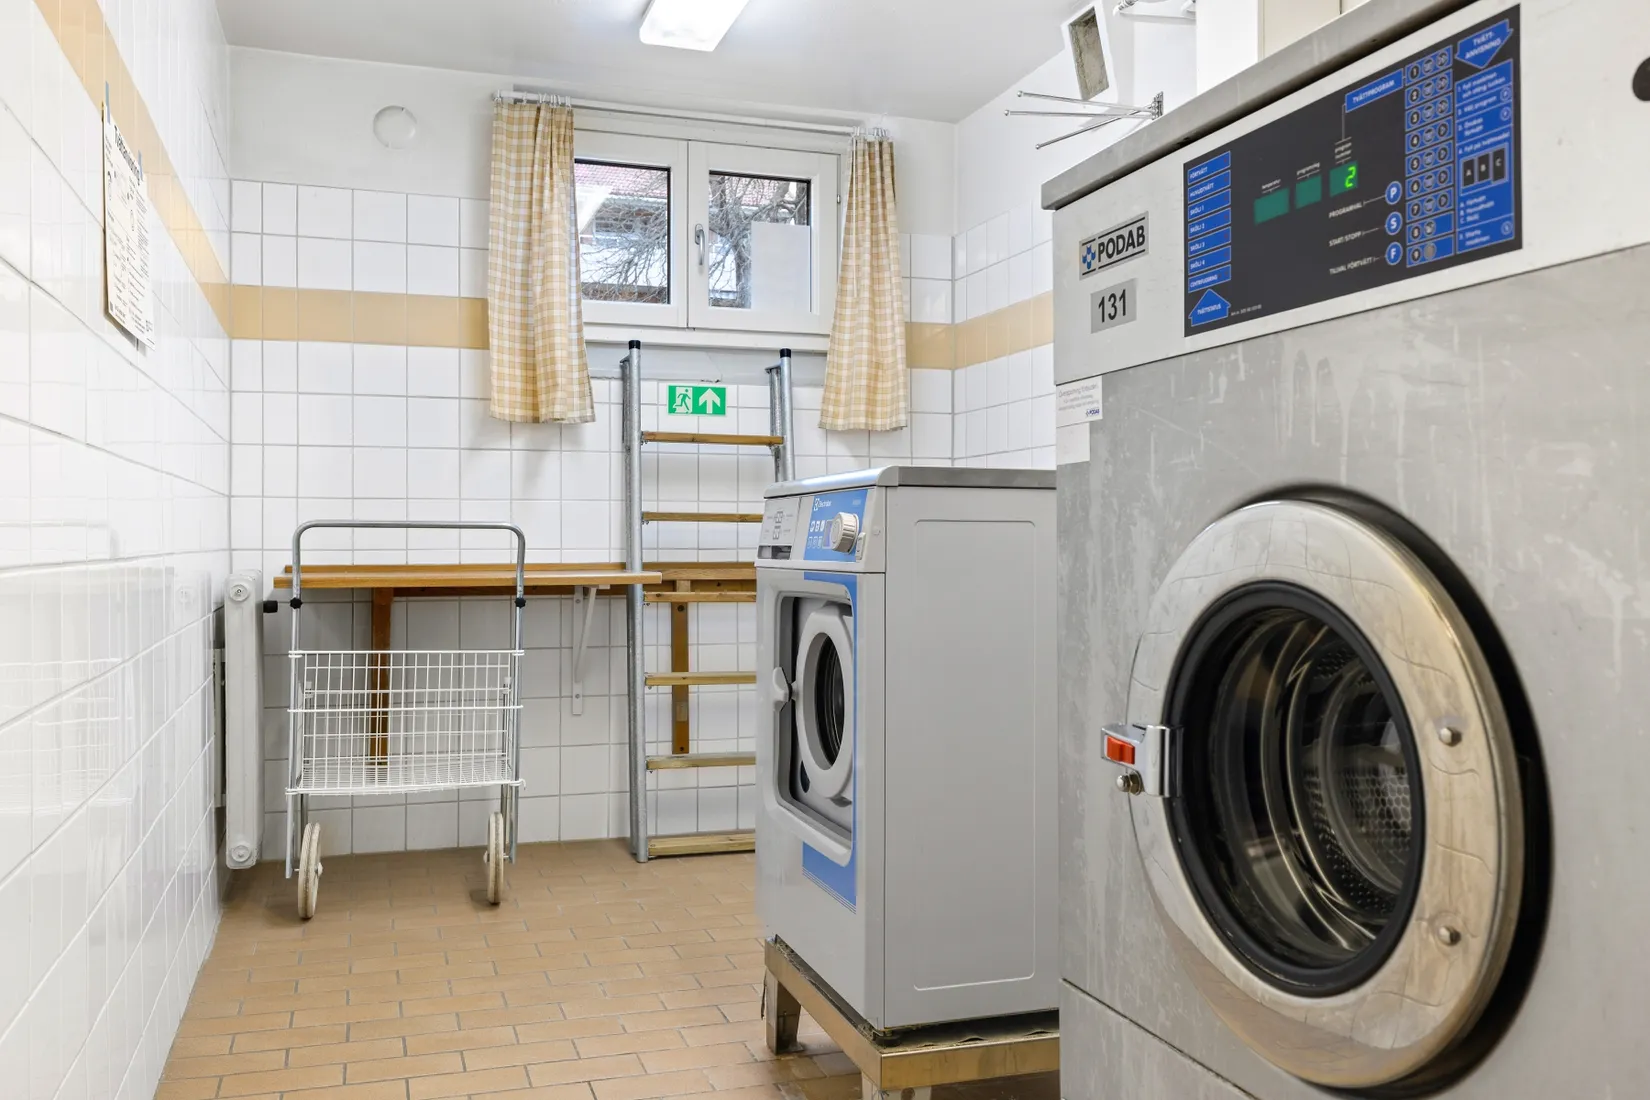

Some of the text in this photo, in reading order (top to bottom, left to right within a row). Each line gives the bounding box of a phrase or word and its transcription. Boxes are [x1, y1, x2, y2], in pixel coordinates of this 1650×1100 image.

[1480, 164, 1487, 173] B
[1495, 158, 1502, 167] C
[1344, 165, 1357, 188] 2
[1466, 169, 1472, 178] A
[1389, 187, 1398, 199] P
[1328, 201, 1363, 219] PROGRAMVAL
[1389, 217, 1398, 230] S
[1098, 225, 1146, 263] PODAB
[1389, 247, 1397, 260] F
[1098, 288, 1127, 323] 131
